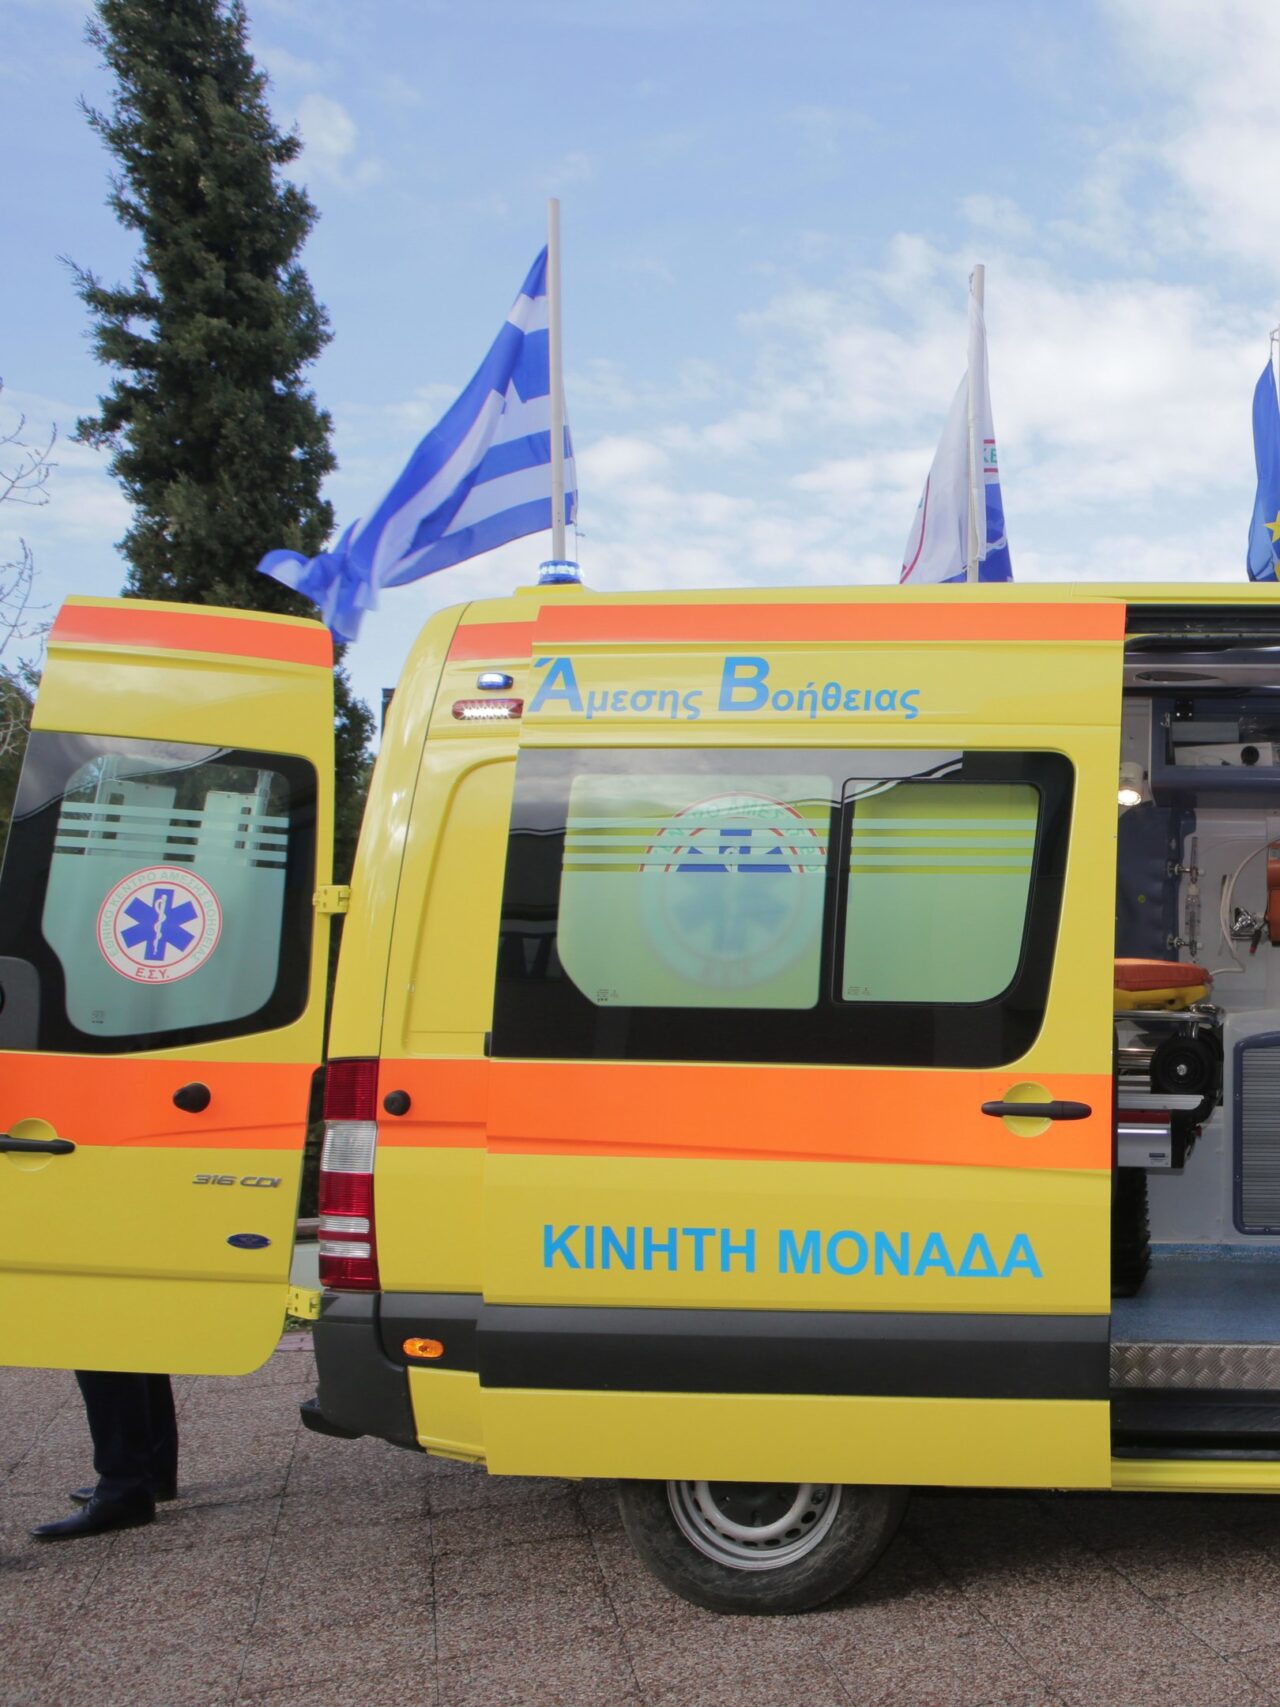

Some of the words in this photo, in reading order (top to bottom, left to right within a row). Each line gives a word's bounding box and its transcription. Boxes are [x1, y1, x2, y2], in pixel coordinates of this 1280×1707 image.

[528, 656, 703, 720] Άμεσης
[717, 655, 920, 720] Βοήθειας
[111, 871, 157, 909] ΚΕΝΤΡΟ
[192, 1174, 237, 1186] 316
[240, 1176, 282, 1188] CDI
[543, 1224, 756, 1273] ΚΙΝΗΤΗ
[778, 1229, 1044, 1278] ΜΟΝΑΔΑ
